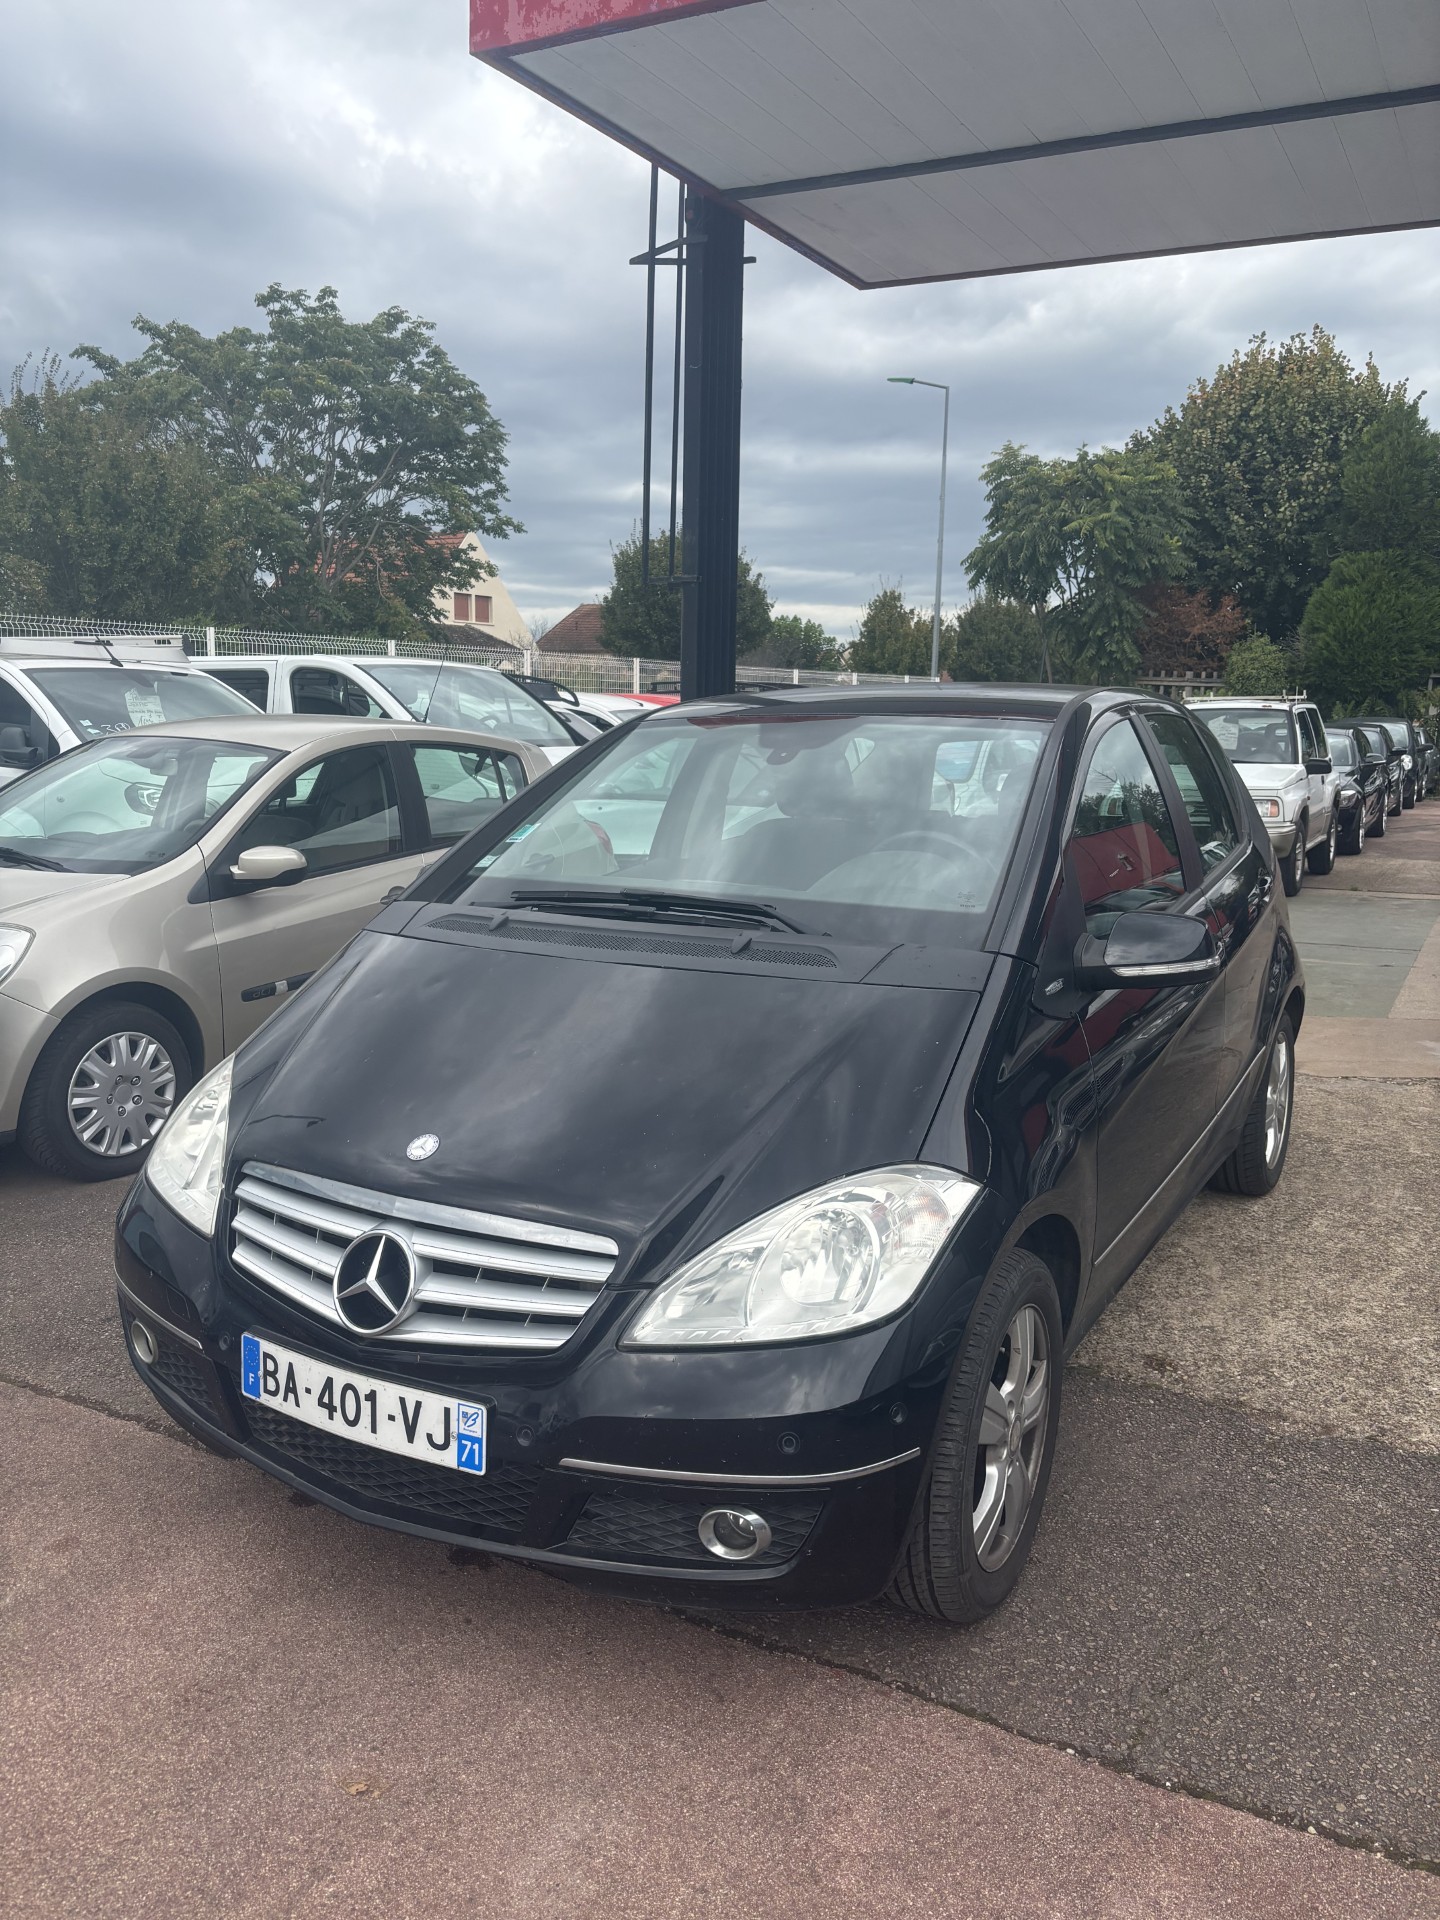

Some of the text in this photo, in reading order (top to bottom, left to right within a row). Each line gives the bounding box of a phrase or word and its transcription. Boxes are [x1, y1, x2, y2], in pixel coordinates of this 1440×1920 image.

[248, 1372, 255, 1386] F
[262, 1351, 451, 1451] BA-401-VJ
[461, 1439, 479, 1466] 71
